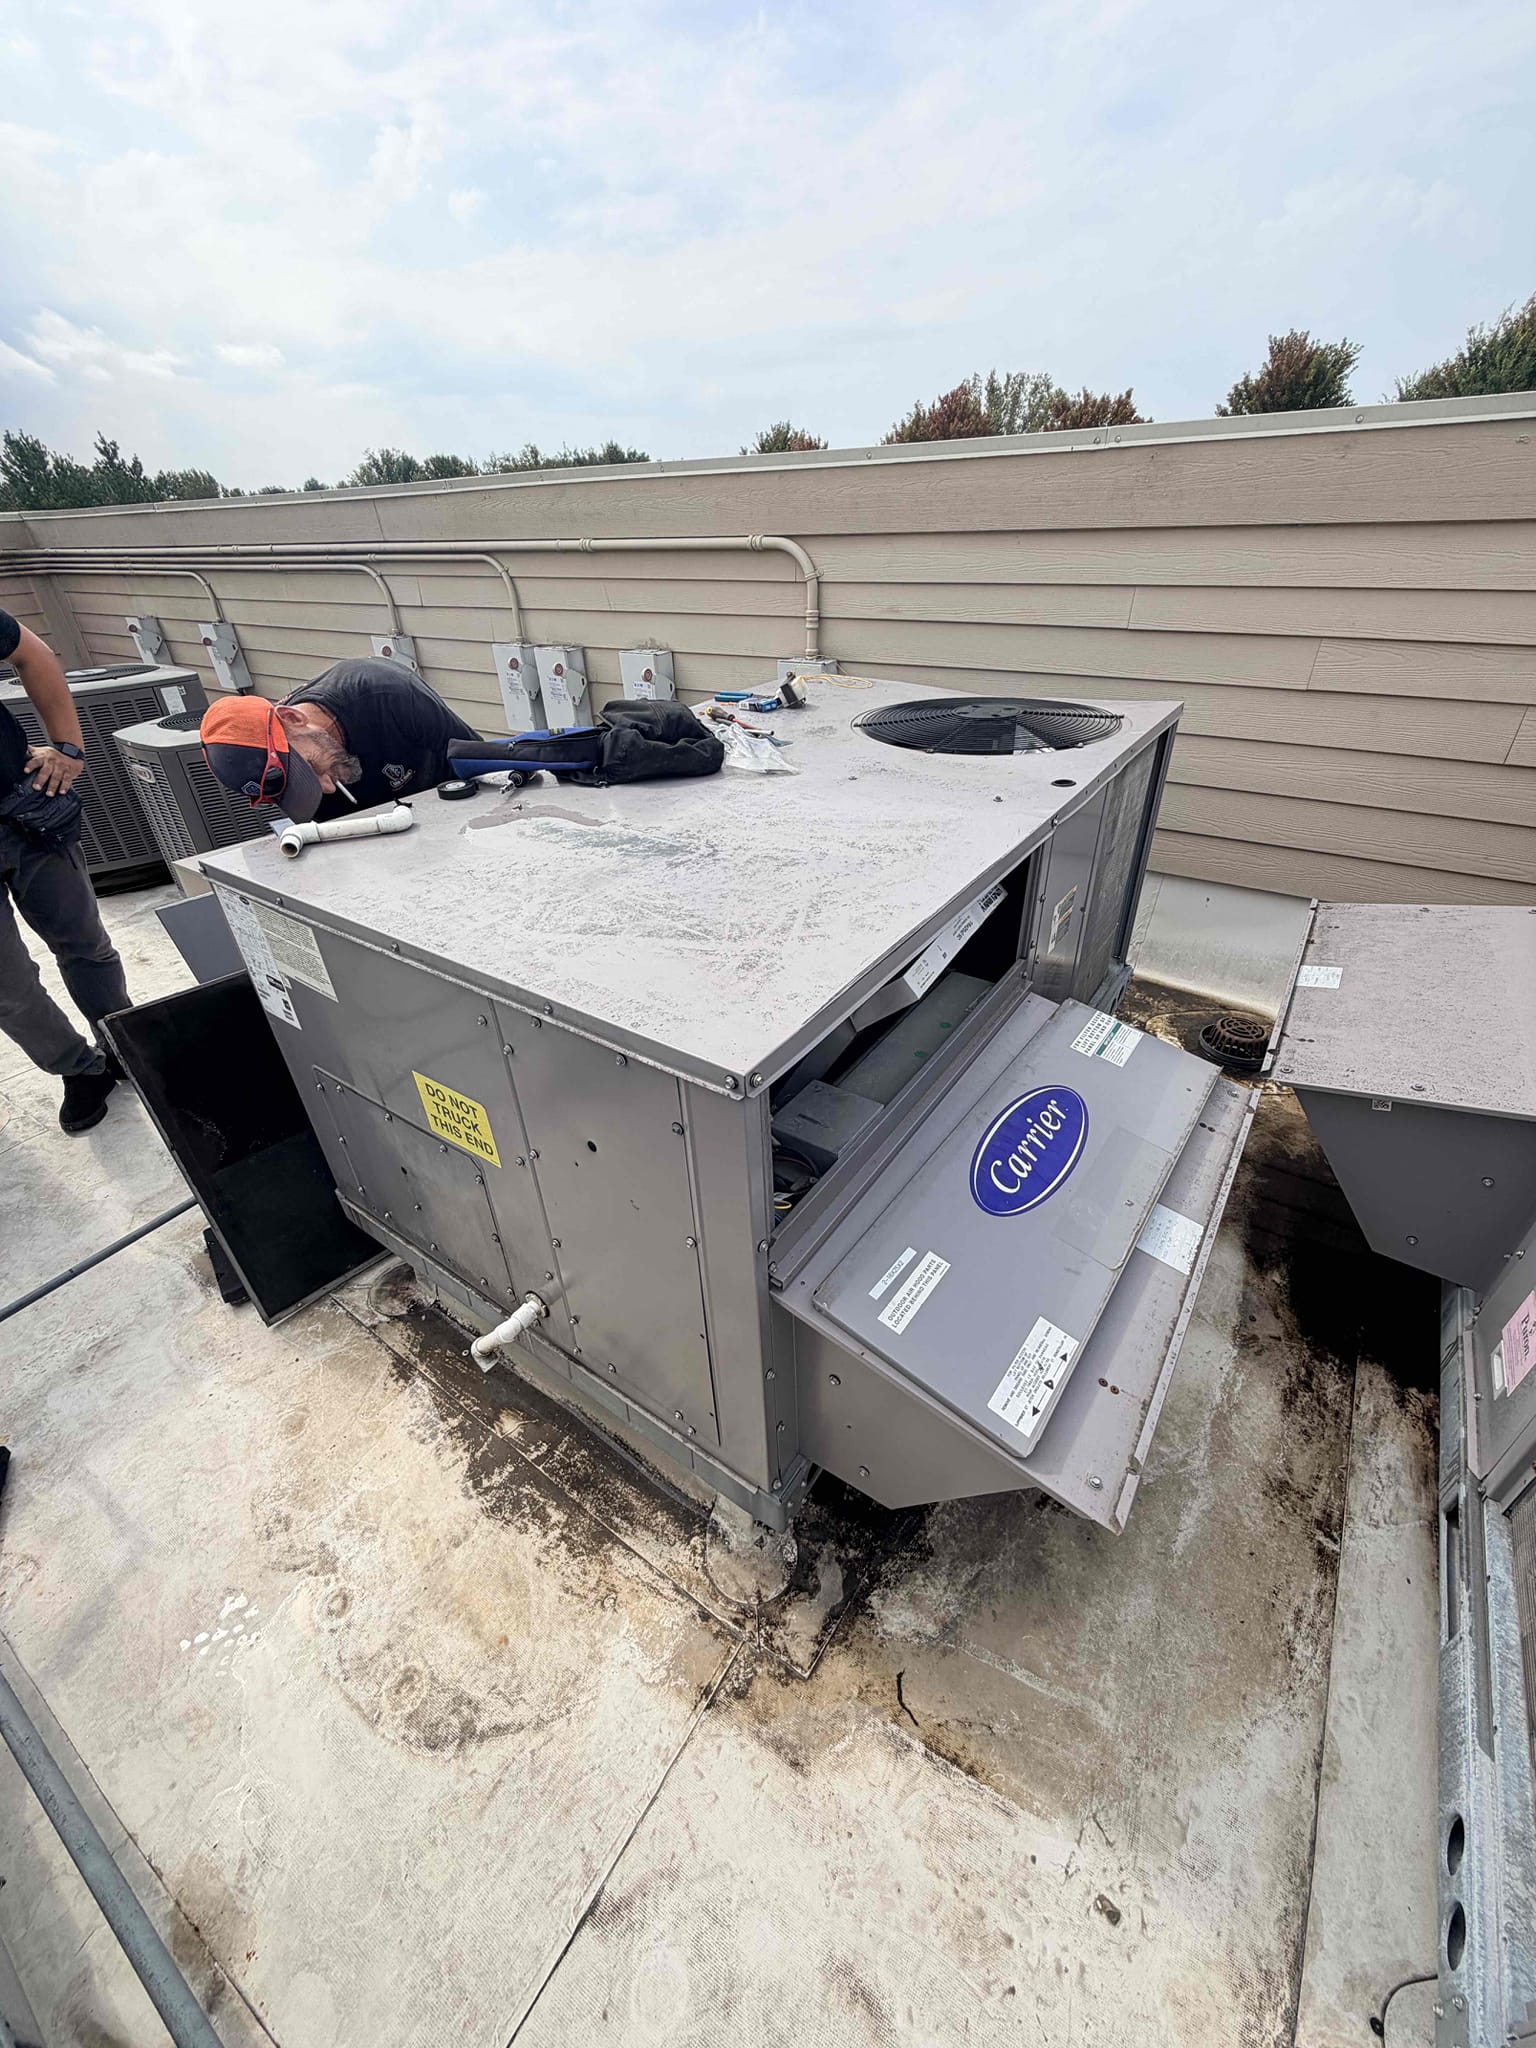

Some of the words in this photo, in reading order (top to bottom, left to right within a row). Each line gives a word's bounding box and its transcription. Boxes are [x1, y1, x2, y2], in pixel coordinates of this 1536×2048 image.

[425, 1083, 446, 1102] DO
[448, 1095, 477, 1118] NOT
[432, 1101, 482, 1136] TRUCK
[431, 1114, 462, 1138] THIS
[465, 1132, 493, 1155] END
[990, 1100, 1066, 1194] Carrier
[888, 1296, 908, 1321] OUTDOOR
[912, 1274, 925, 1288] HOOD
[923, 1259, 936, 1274] PARTS
[892, 1305, 911, 1328] LOCATED
[909, 1286, 925, 1304] BEHIND
[922, 1276, 932, 1287] THIS
[931, 1262, 944, 1276] PANEL
